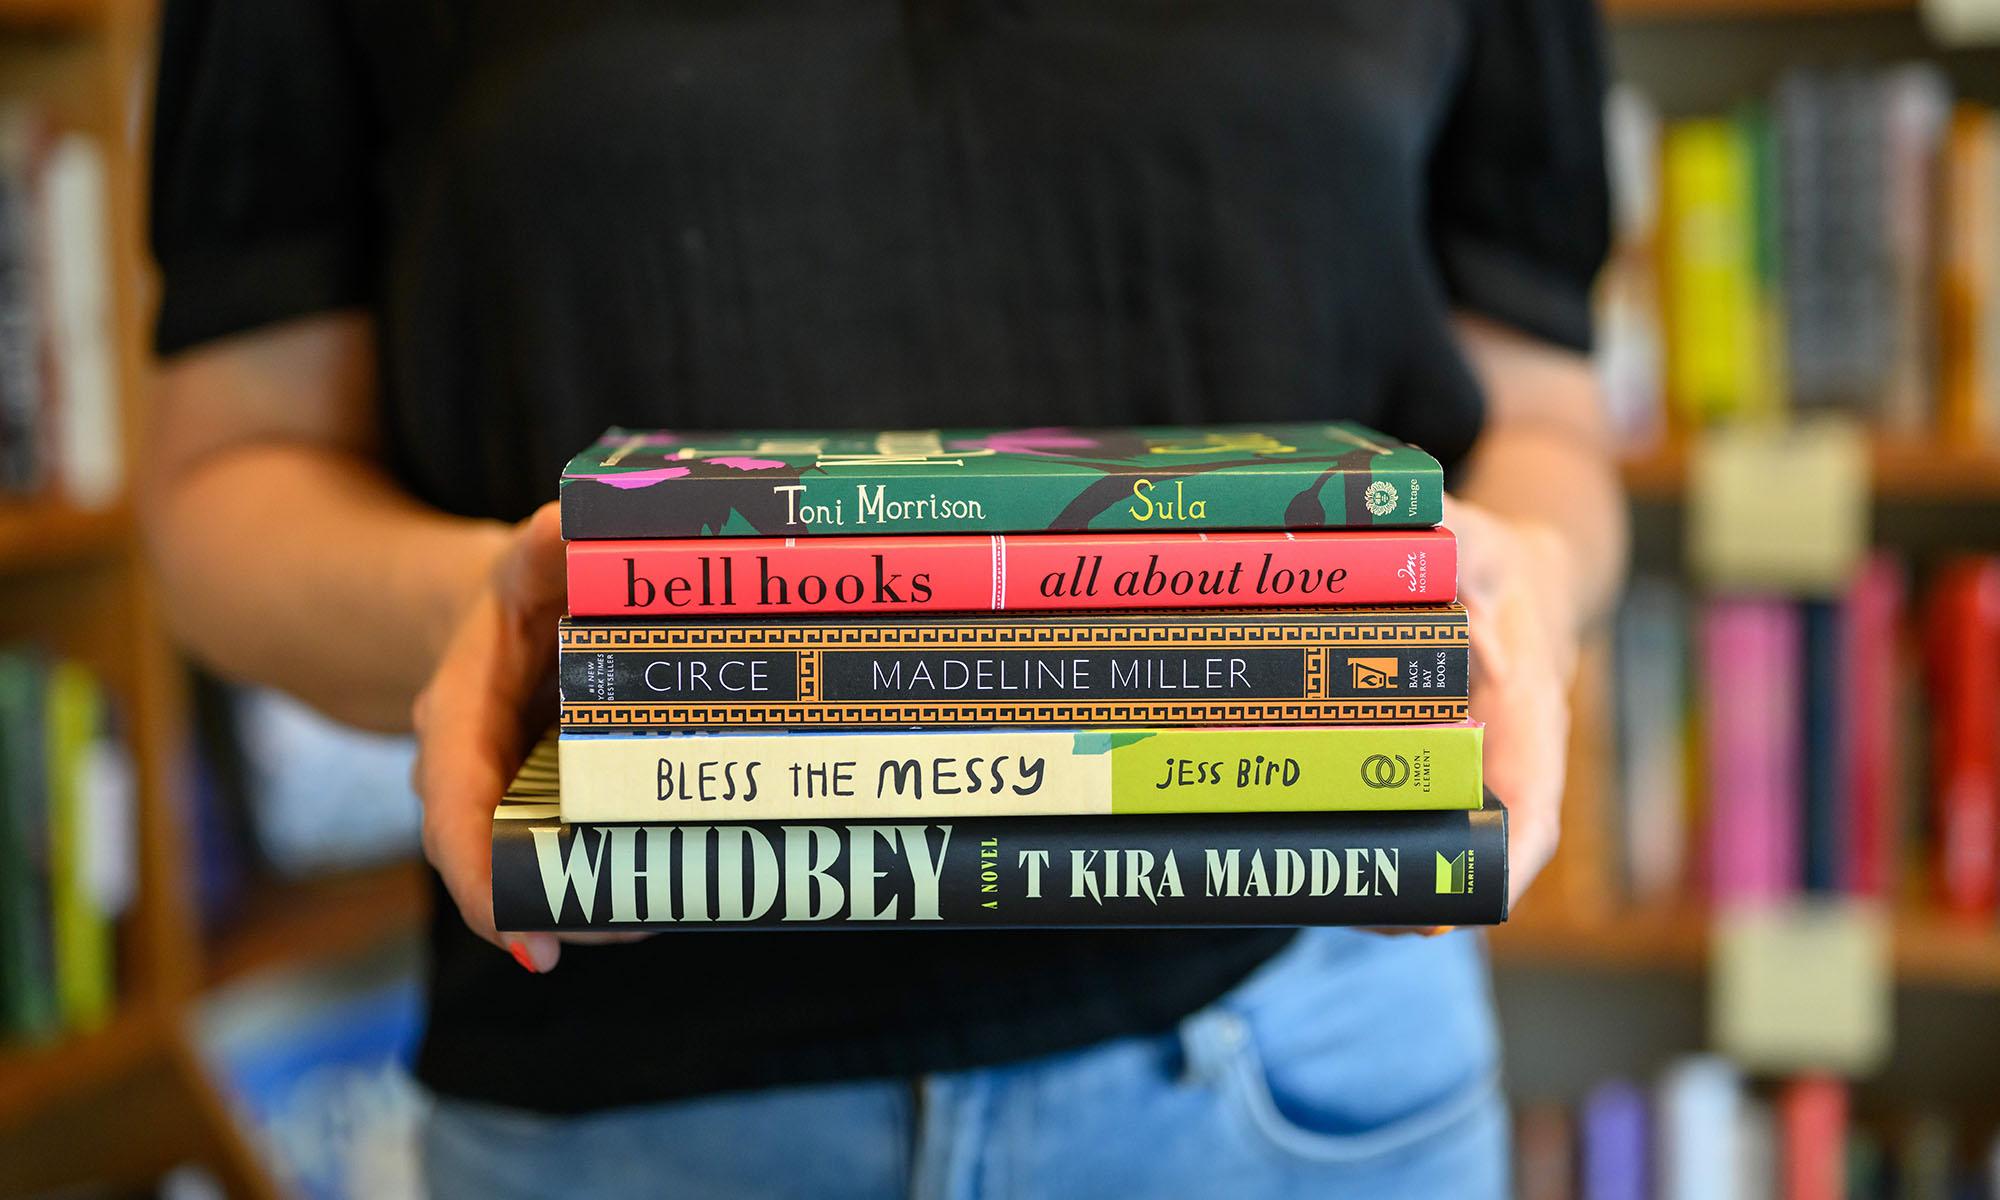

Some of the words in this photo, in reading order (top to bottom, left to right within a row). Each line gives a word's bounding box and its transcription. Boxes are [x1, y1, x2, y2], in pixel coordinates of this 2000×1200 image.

[774, 485, 844, 526] Toni
[855, 484, 986, 524] Morrison
[1129, 479, 1207, 521] Sula
[1408, 479, 1420, 517] Vintage
[623, 557, 737, 607] bell
[756, 554, 933, 605] hooks
[1039, 555, 1103, 597] all
[1113, 555, 1243, 596] about
[1256, 553, 1347, 594] love
[1419, 551, 1427, 593] MORROW
[597, 653, 605, 676] TIMES
[607, 654, 615, 701] BESTSELLER
[644, 660, 769, 692] CIRCE
[872, 659, 1090, 691] MADELINE
[1110, 657, 1251, 689] MILLER
[1408, 660, 1419, 689] BACK
[1422, 669, 1432, 688] BAY
[1436, 651, 1447, 688] BOOKS
[597, 678, 605, 700] YORK
[656, 758, 762, 802] BLESS
[1423, 748, 1431, 793] ELEMENT
[528, 824, 954, 924] WHIDBEY
[980, 837, 999, 893] NOVEL
[1018, 850, 1050, 898] T
[1069, 848, 1185, 906] KIRA
[1204, 847, 1400, 898] MADDEN
[1467, 849, 1475, 894] MARINER
[980, 900, 998, 910] A
